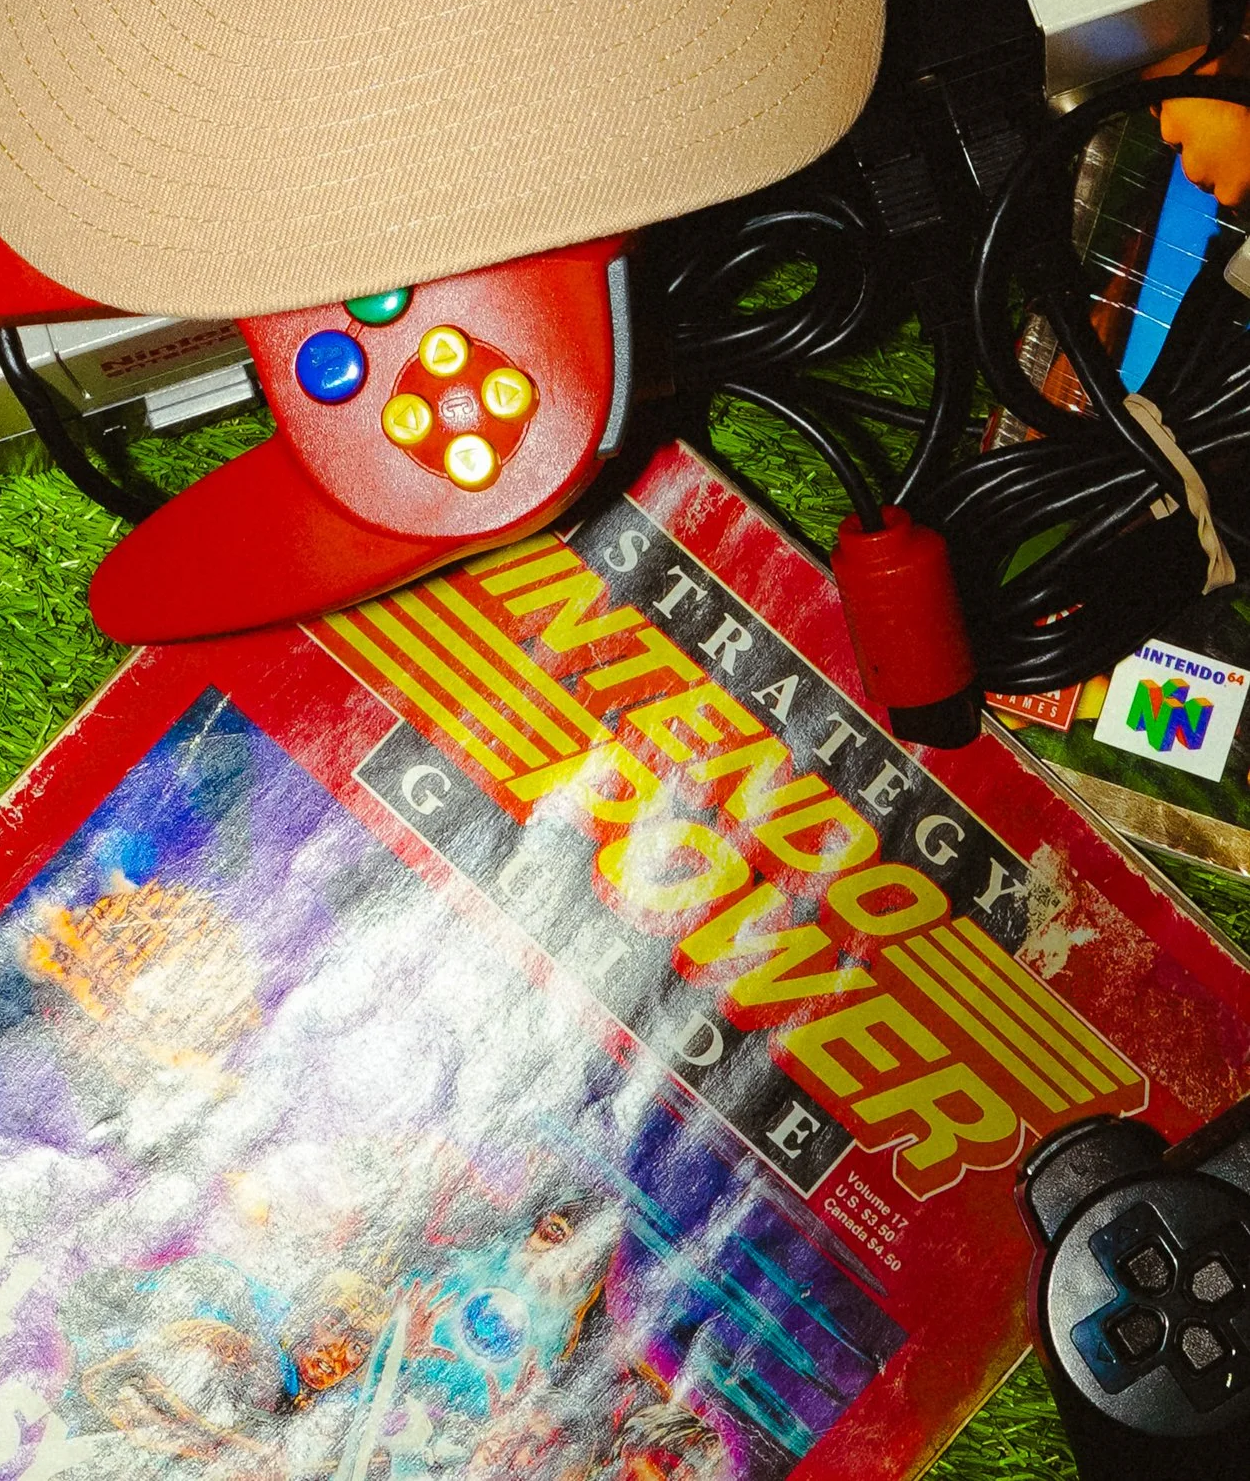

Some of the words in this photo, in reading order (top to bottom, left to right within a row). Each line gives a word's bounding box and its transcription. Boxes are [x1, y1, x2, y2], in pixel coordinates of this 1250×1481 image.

[1227, 670, 1245, 687] 64
[601, 527, 1027, 916] STRATEGY
[505, 736, 1019, 1173] POWER
[834, 1183, 862, 1214] U.S.
[859, 1205, 898, 1245] $3.50
[846, 1170, 897, 1219] Volume
[822, 1196, 870, 1246] Canada
[865, 1237, 903, 1274] $4.50
